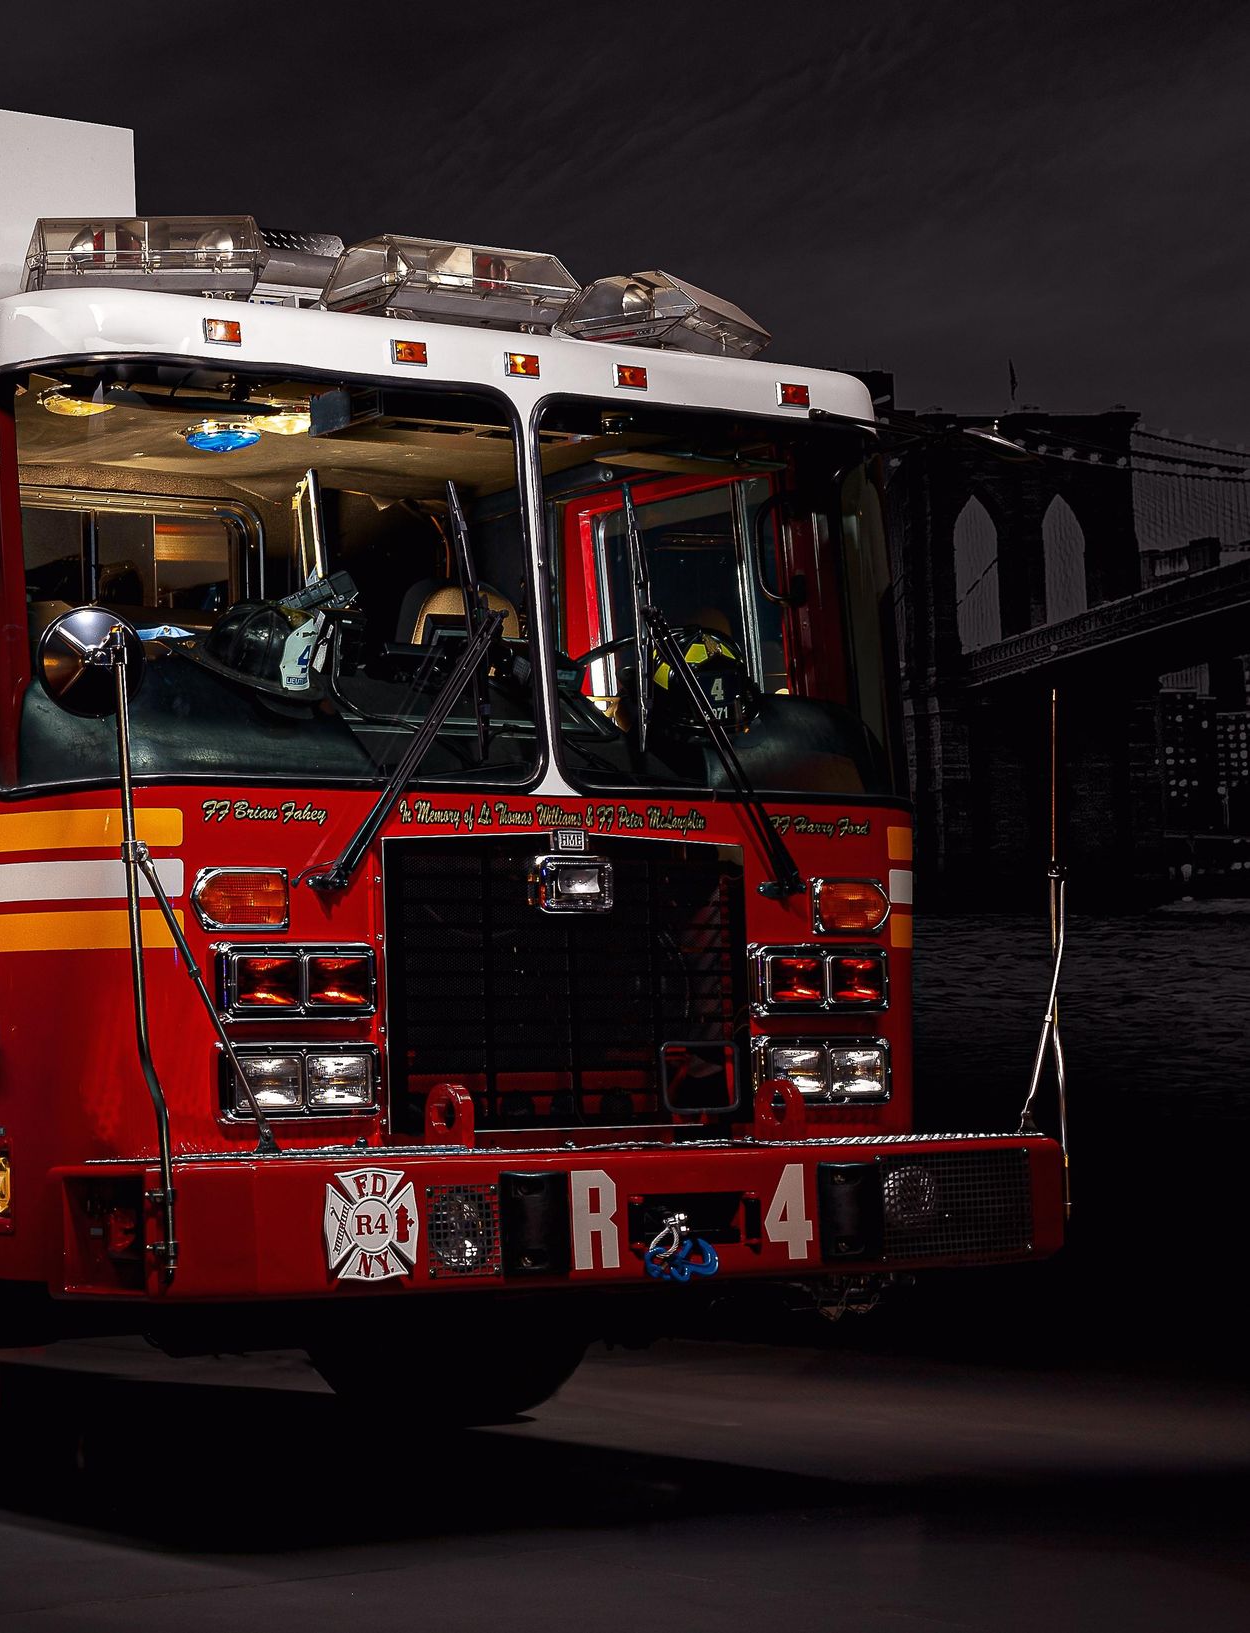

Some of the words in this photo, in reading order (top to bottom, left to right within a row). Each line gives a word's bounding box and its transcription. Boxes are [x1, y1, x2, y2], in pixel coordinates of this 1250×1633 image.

[297, 645, 311, 673] 4
[711, 678, 724, 701] 4
[202, 800, 231, 822] FF
[233, 799, 278, 820] Brian
[281, 801, 327, 825] Fahey
[399, 799, 413, 823] In
[414, 800, 460, 830] Memory
[463, 804, 474, 831] of
[494, 802, 533, 825] Thomas
[536, 803, 582, 827] Williams
[585, 805, 594, 827] &
[597, 806, 614, 831] FF
[618, 806, 644, 828] Peter
[648, 806, 706, 835] McLaughlin
[769, 816, 791, 835] FF
[793, 816, 834, 837] Harry
[837, 818, 869, 836] Ford
[355, 1213, 388, 1236] R4
[570, 1169, 620, 1270] R
[764, 1163, 813, 1260] 4
